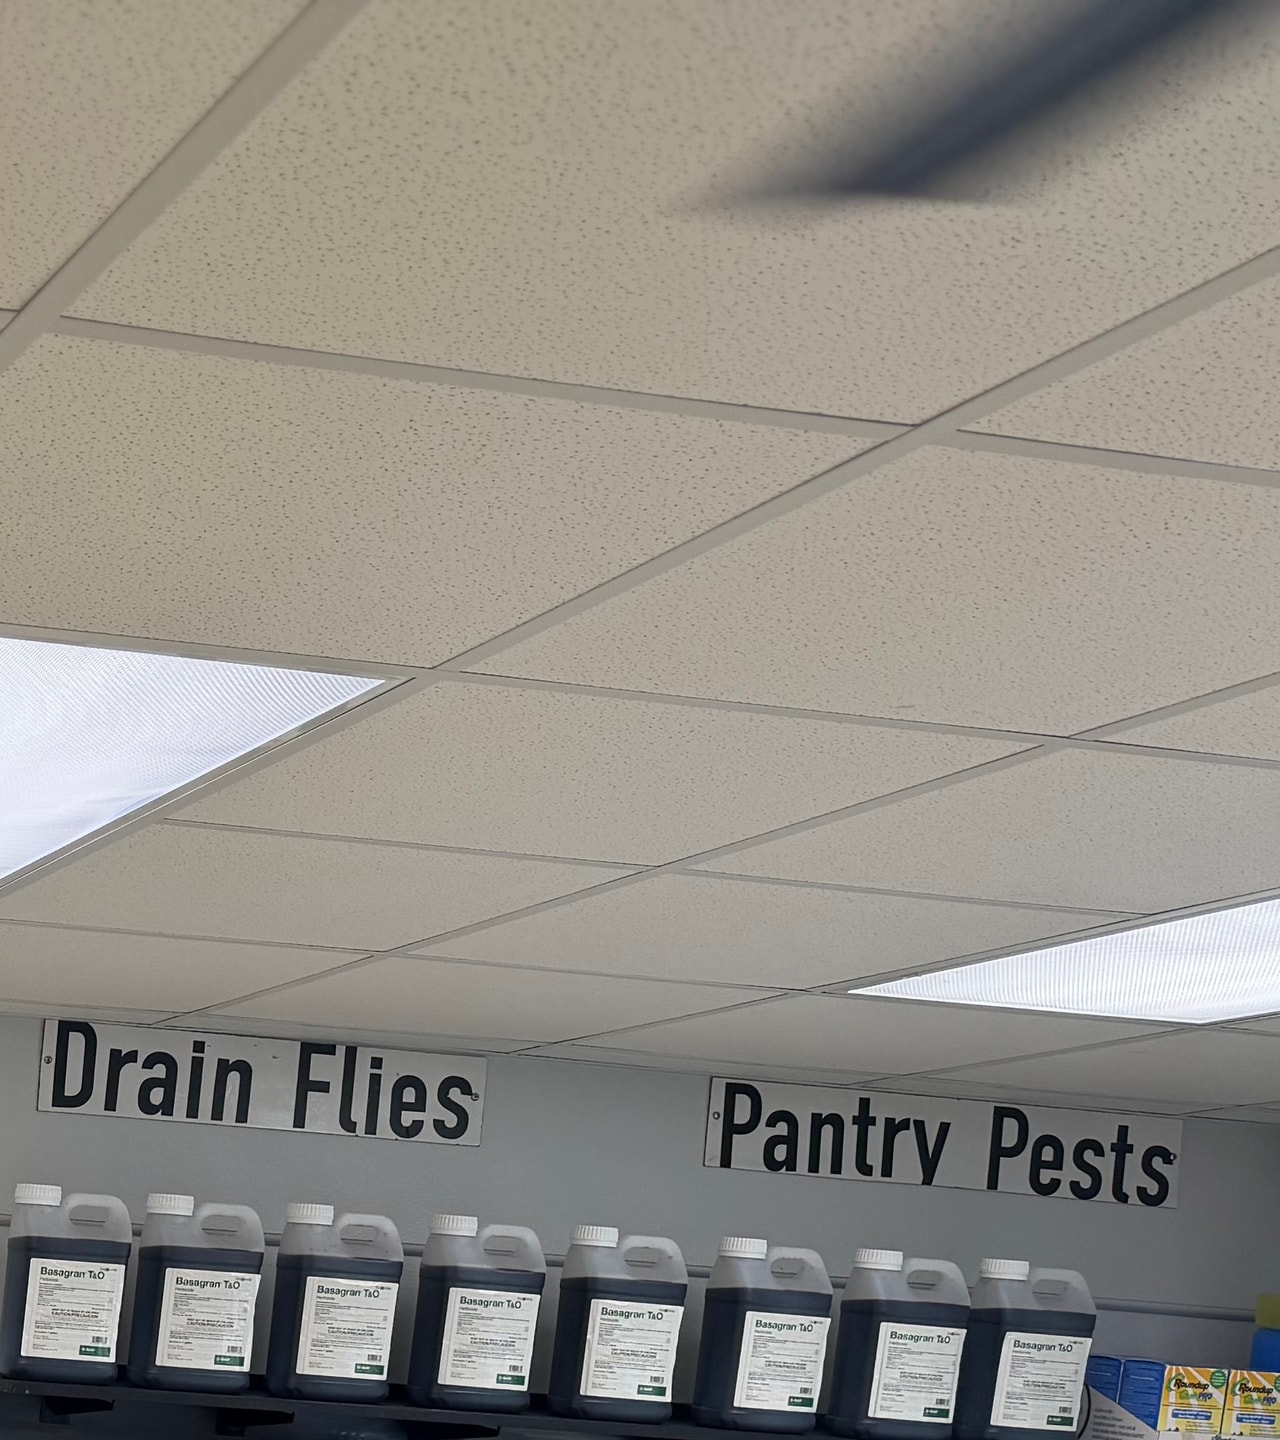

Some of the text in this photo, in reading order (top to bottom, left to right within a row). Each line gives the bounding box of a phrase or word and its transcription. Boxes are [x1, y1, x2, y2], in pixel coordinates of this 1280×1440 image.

[51, 1020, 474, 1140] Drain Flies
[720, 1081, 1175, 1207] Pantry Pests
[40, 1265, 85, 1280] Basagran
[176, 1276, 221, 1289] Basagran
[317, 1285, 361, 1298] Basagran
[460, 1296, 504, 1309] Basagran
[1174, 1378, 1210, 1391] Roundup
[1238, 1383, 1273, 1395] Roundup
